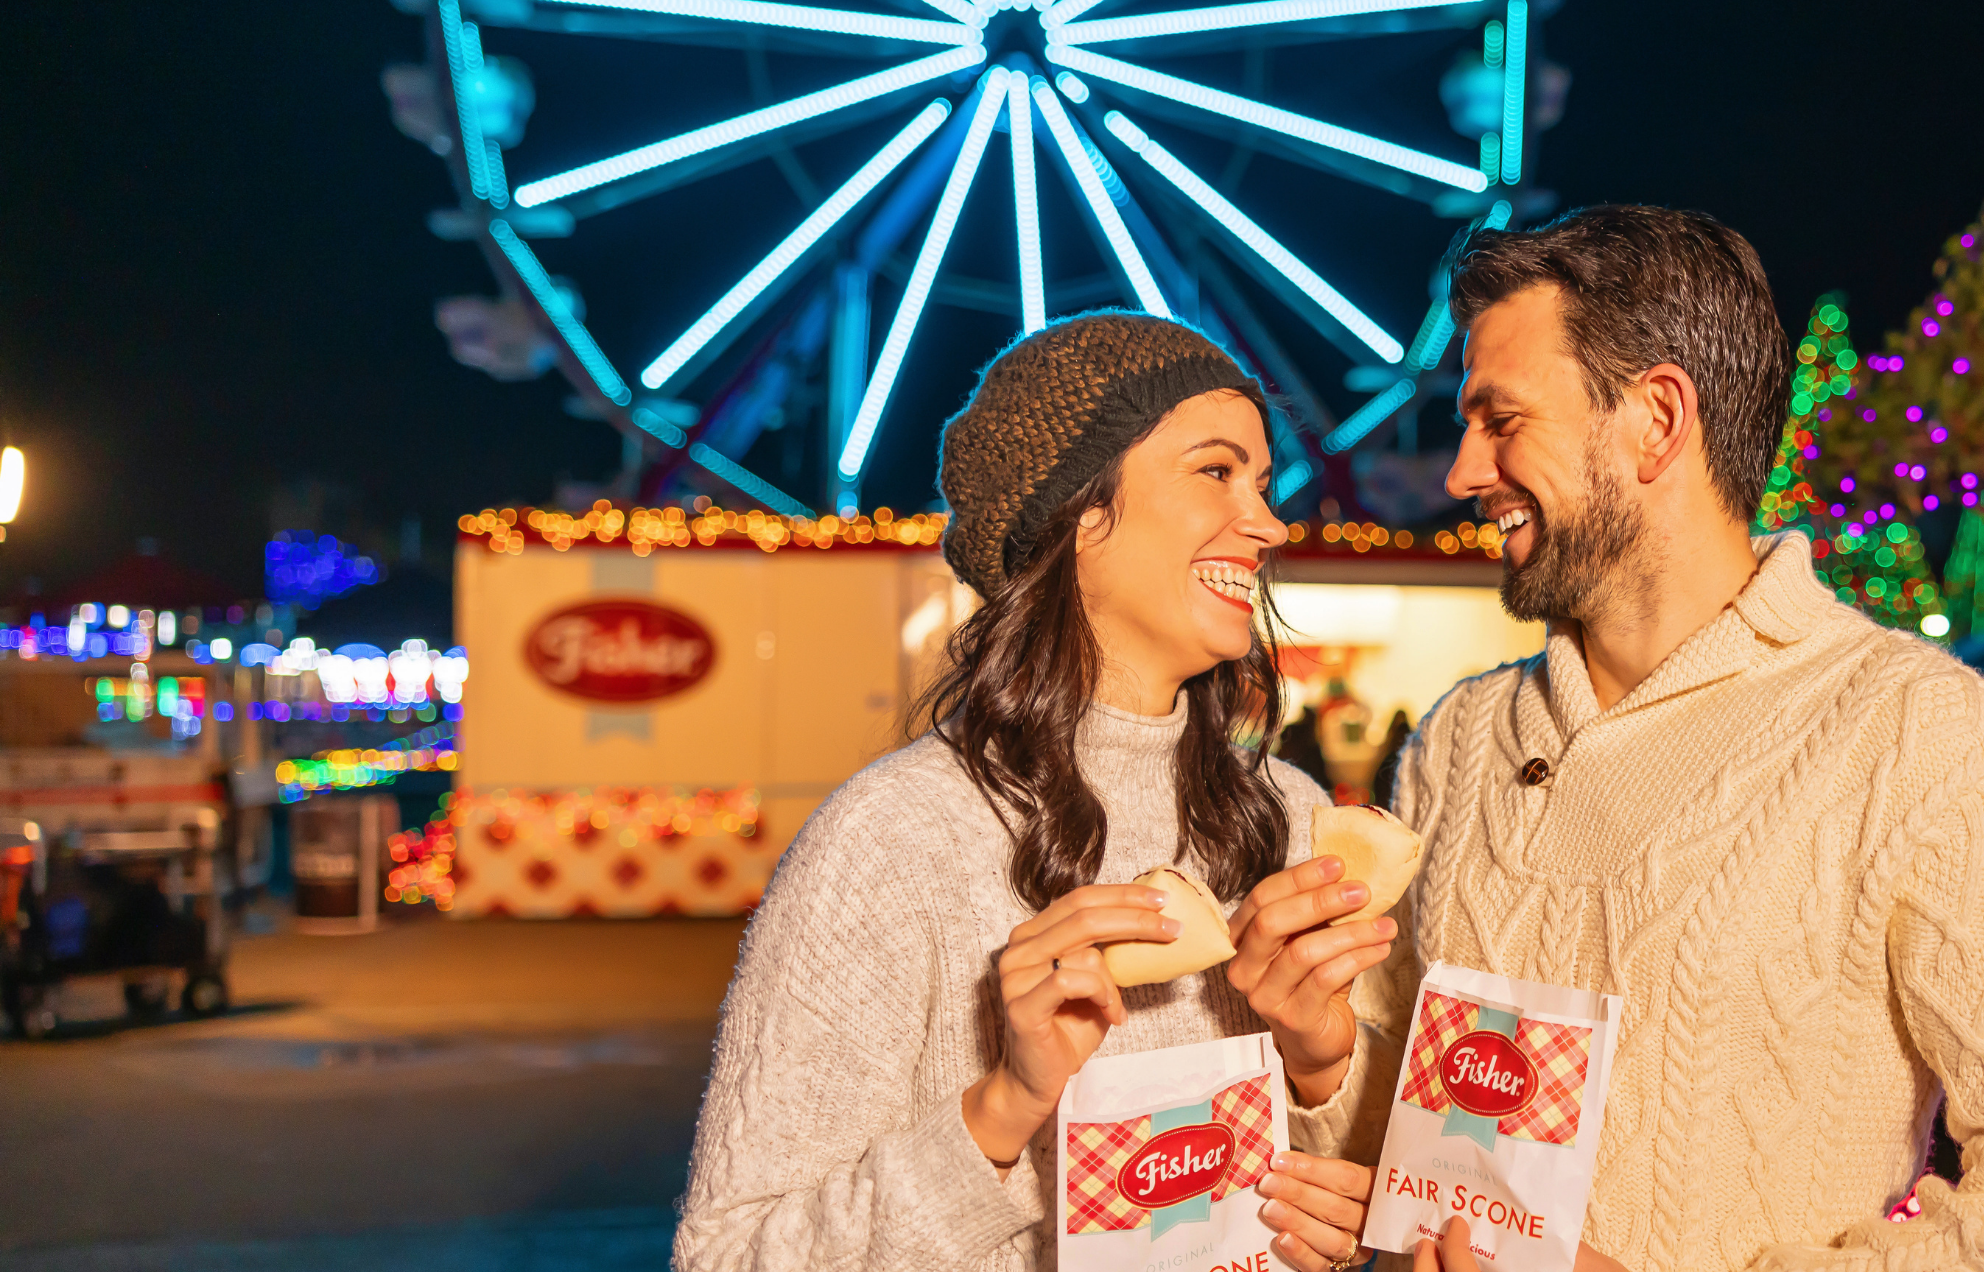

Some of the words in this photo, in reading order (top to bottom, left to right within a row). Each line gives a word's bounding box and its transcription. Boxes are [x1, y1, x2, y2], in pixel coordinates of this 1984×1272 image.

[1449, 1046, 1525, 1097] Fisher
[1135, 1143, 1227, 1196] Fisher
[1431, 1157, 1498, 1186] ORIGINAL
[1386, 1167, 1439, 1204] FAIR
[1451, 1184, 1545, 1239] SCONE
[1146, 1242, 1214, 1272] ORIGINAL
[1416, 1223, 1445, 1241] Natura
[1469, 1241, 1496, 1261] cious
